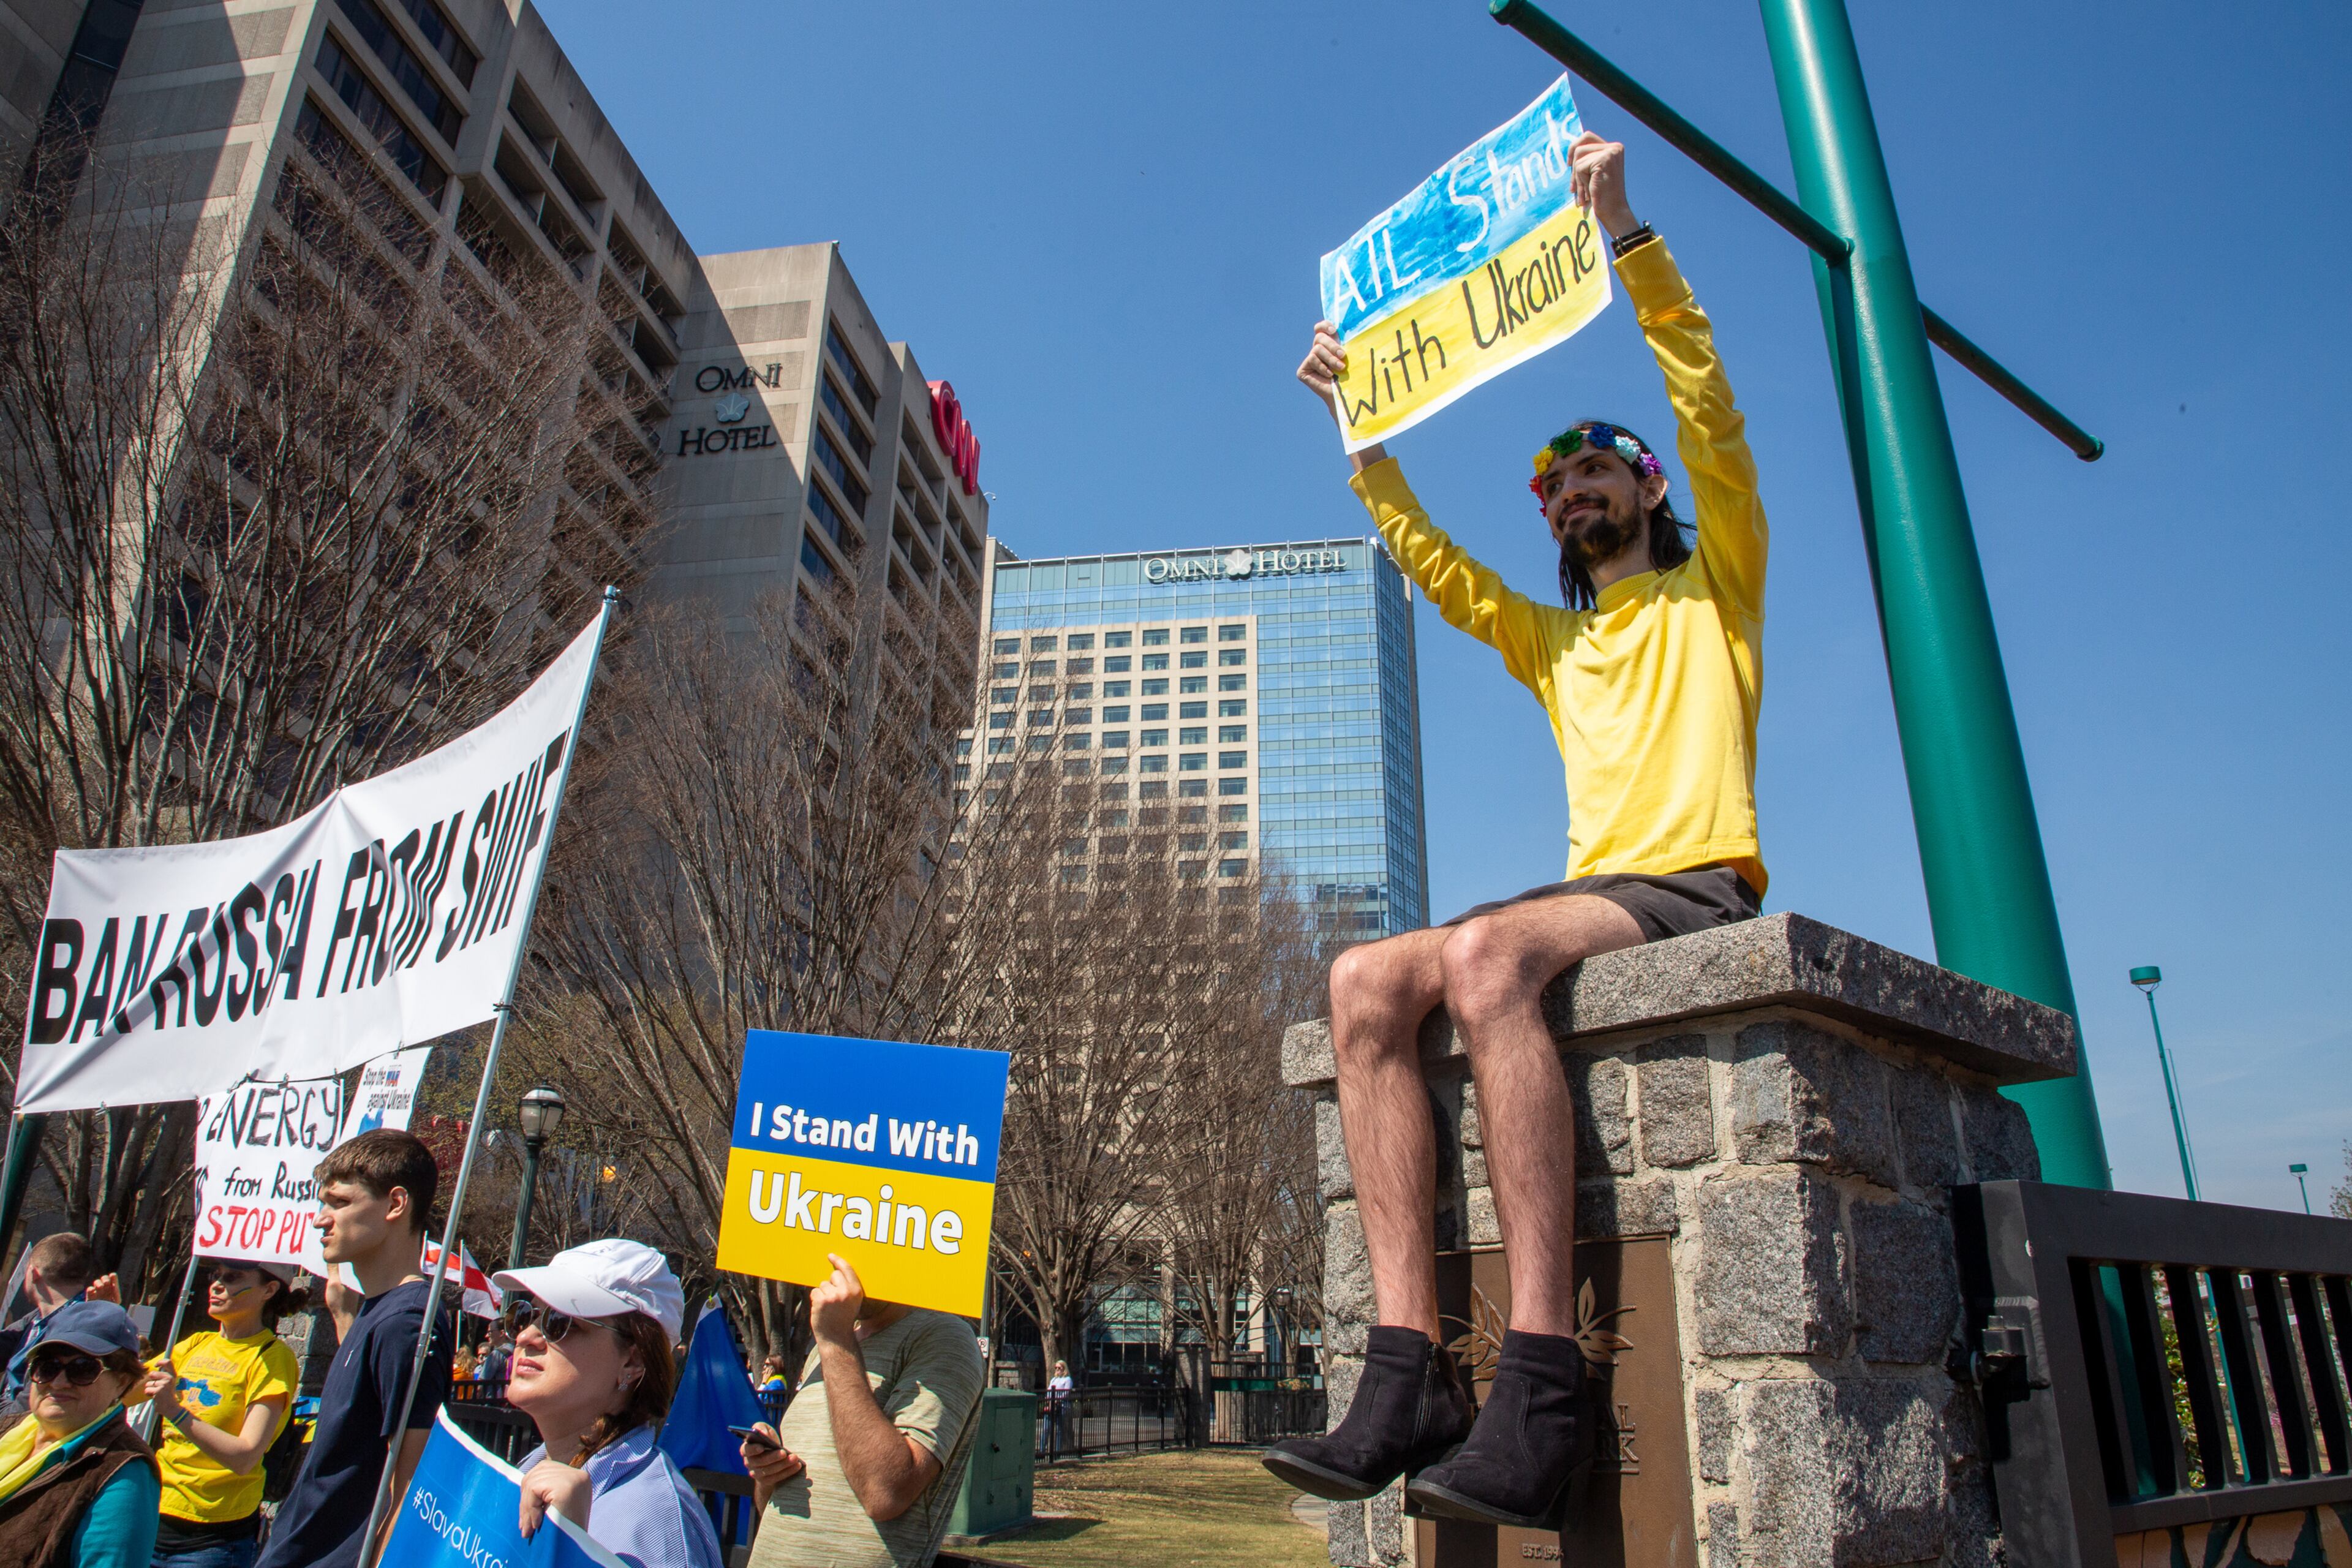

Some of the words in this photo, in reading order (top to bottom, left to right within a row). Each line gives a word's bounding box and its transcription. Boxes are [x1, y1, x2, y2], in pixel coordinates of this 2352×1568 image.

[1333, 219, 1420, 327] ATL
[1333, 318, 1447, 427] With
[1461, 219, 1596, 350] Ukraine
[696, 363, 783, 392] OMNI
[677, 425, 777, 456] HOTEL
[1144, 557, 1221, 581] OMNI
[1256, 549, 1348, 572] HOTEL
[29, 913, 170, 1045] BAN
[316, 809, 465, 998] FROM
[435, 726, 571, 963] SWIF
[206, 1086, 340, 1152] ENERGY
[750, 1102, 763, 1137] I
[769, 1104, 880, 1153] Stand
[888, 1118, 979, 1166] With
[199, 1205, 276, 1250] STOP
[748, 1169, 963, 1256] Ukraine
